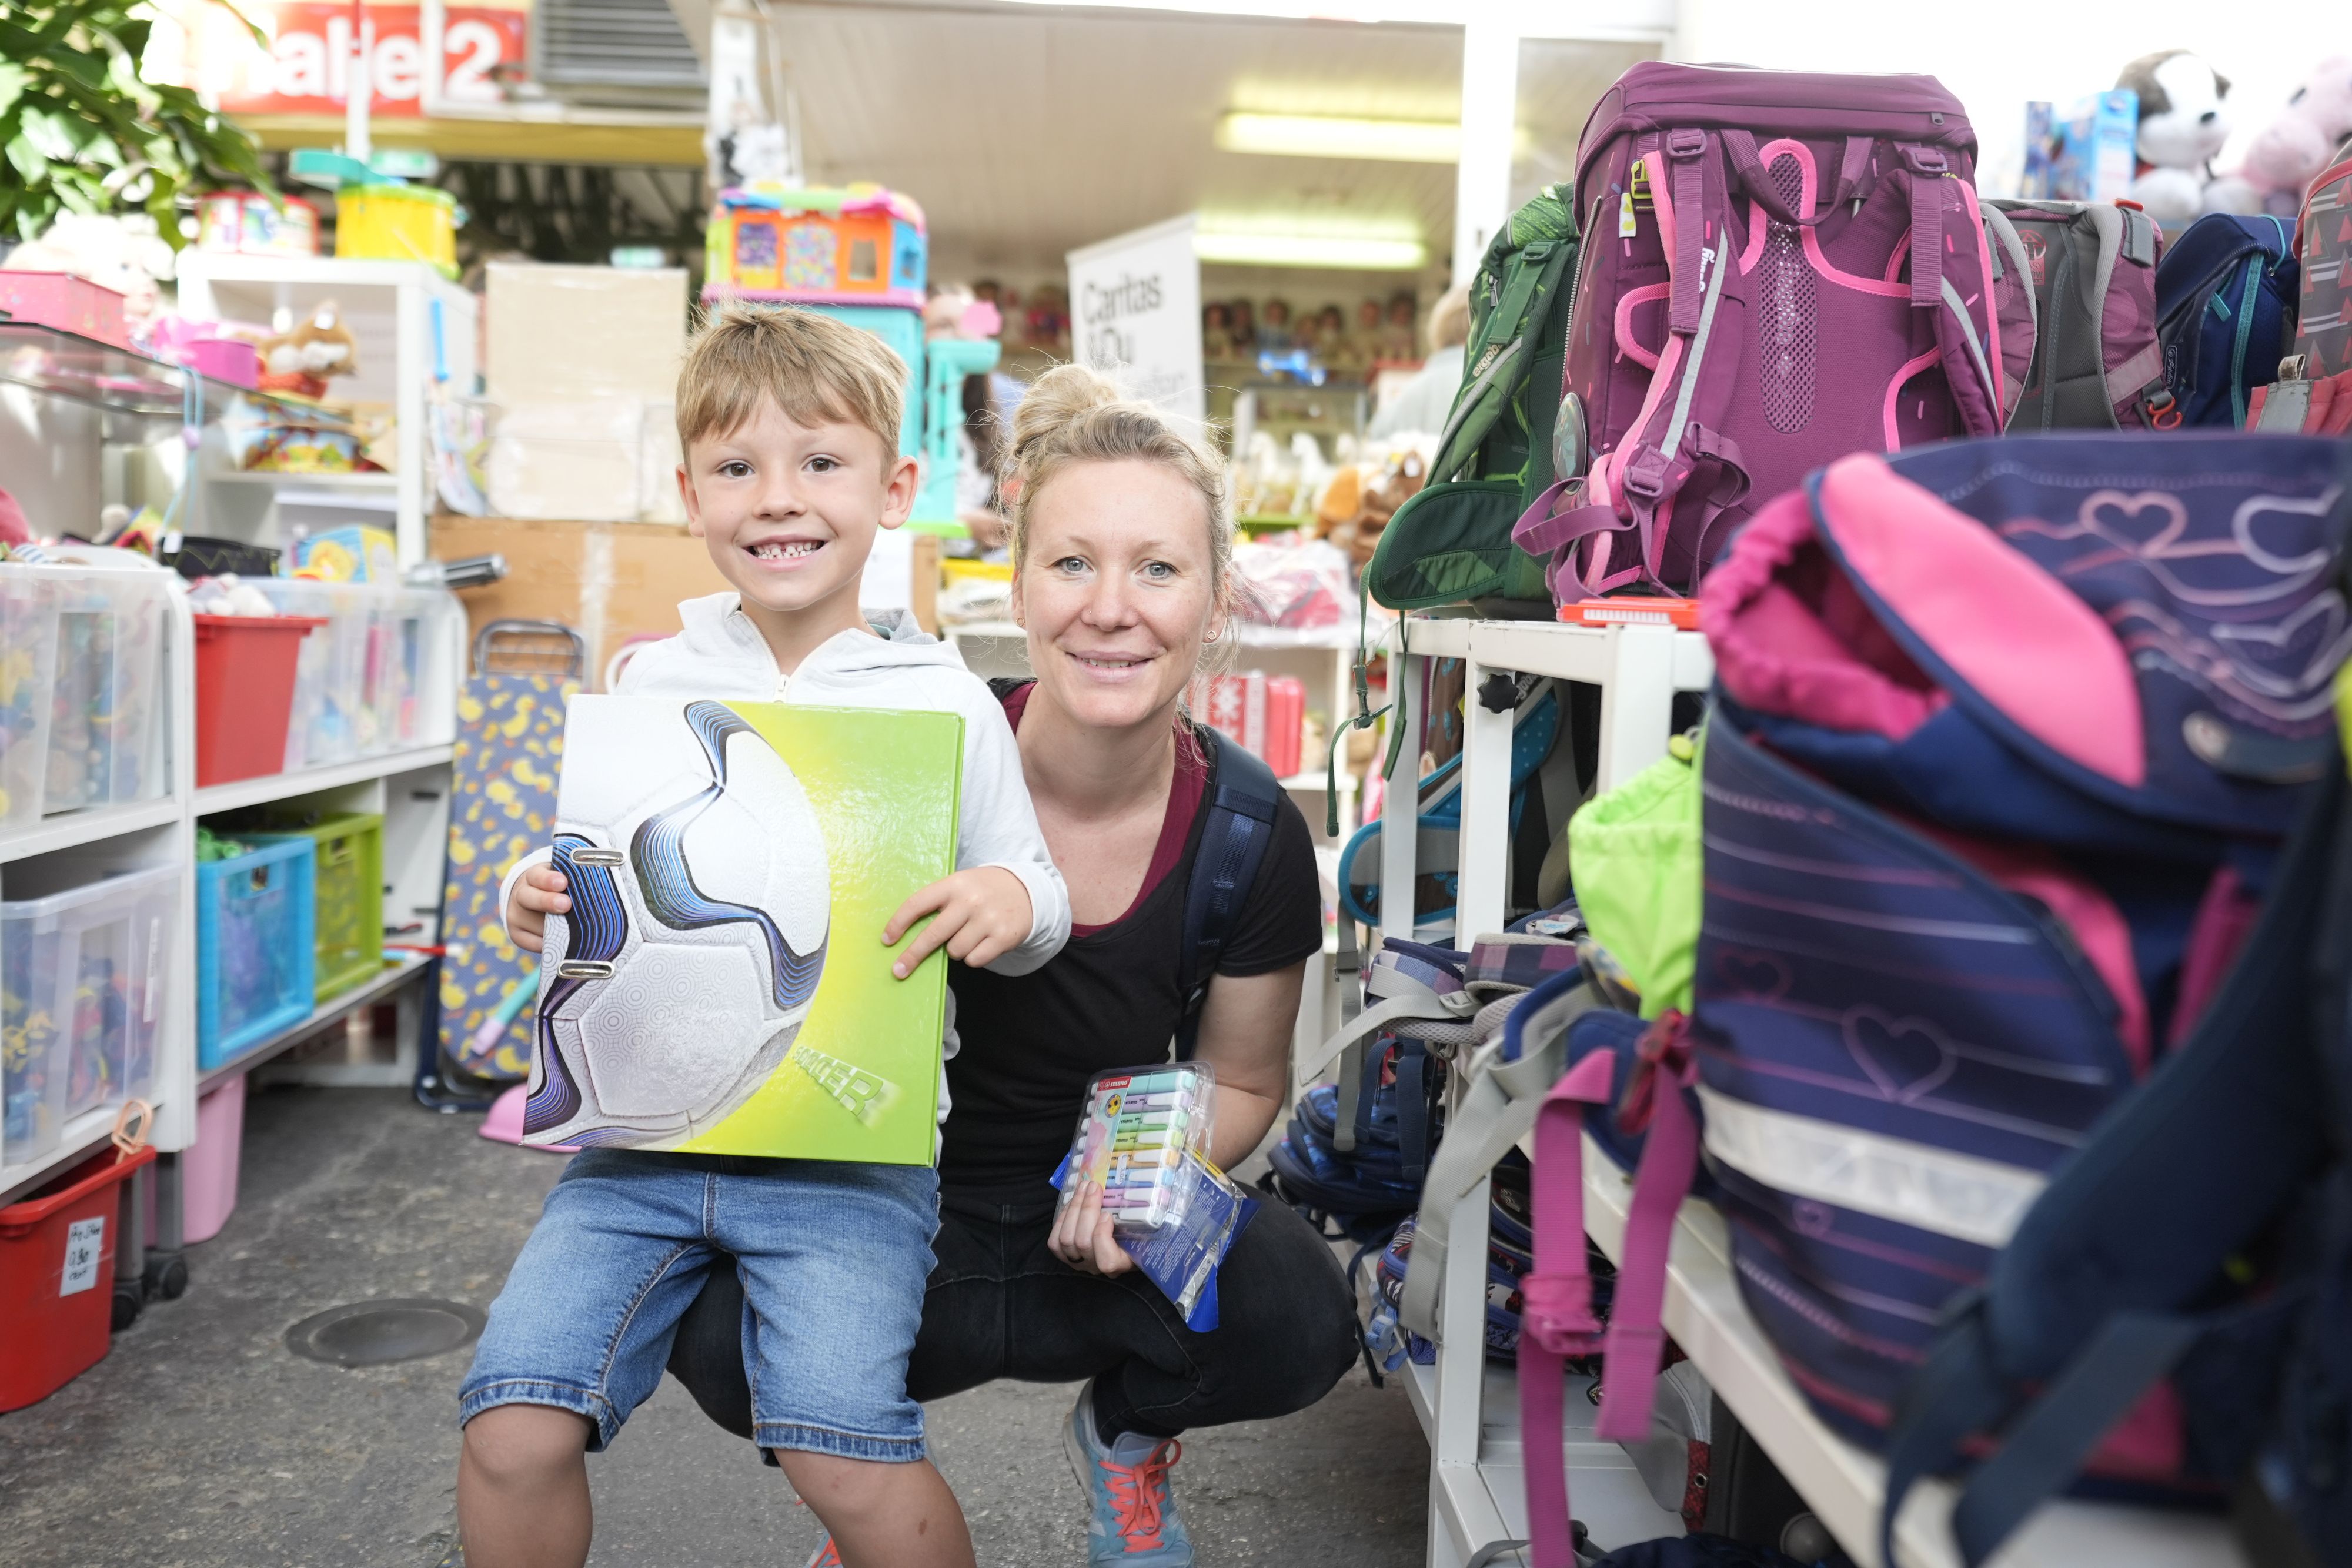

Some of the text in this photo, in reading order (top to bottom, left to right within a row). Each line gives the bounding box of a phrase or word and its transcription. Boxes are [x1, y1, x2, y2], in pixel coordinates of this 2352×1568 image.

[445, 21, 503, 101] 2
[1083, 273, 1161, 325] Caritas
[793, 1043, 884, 1117] SOCCER
